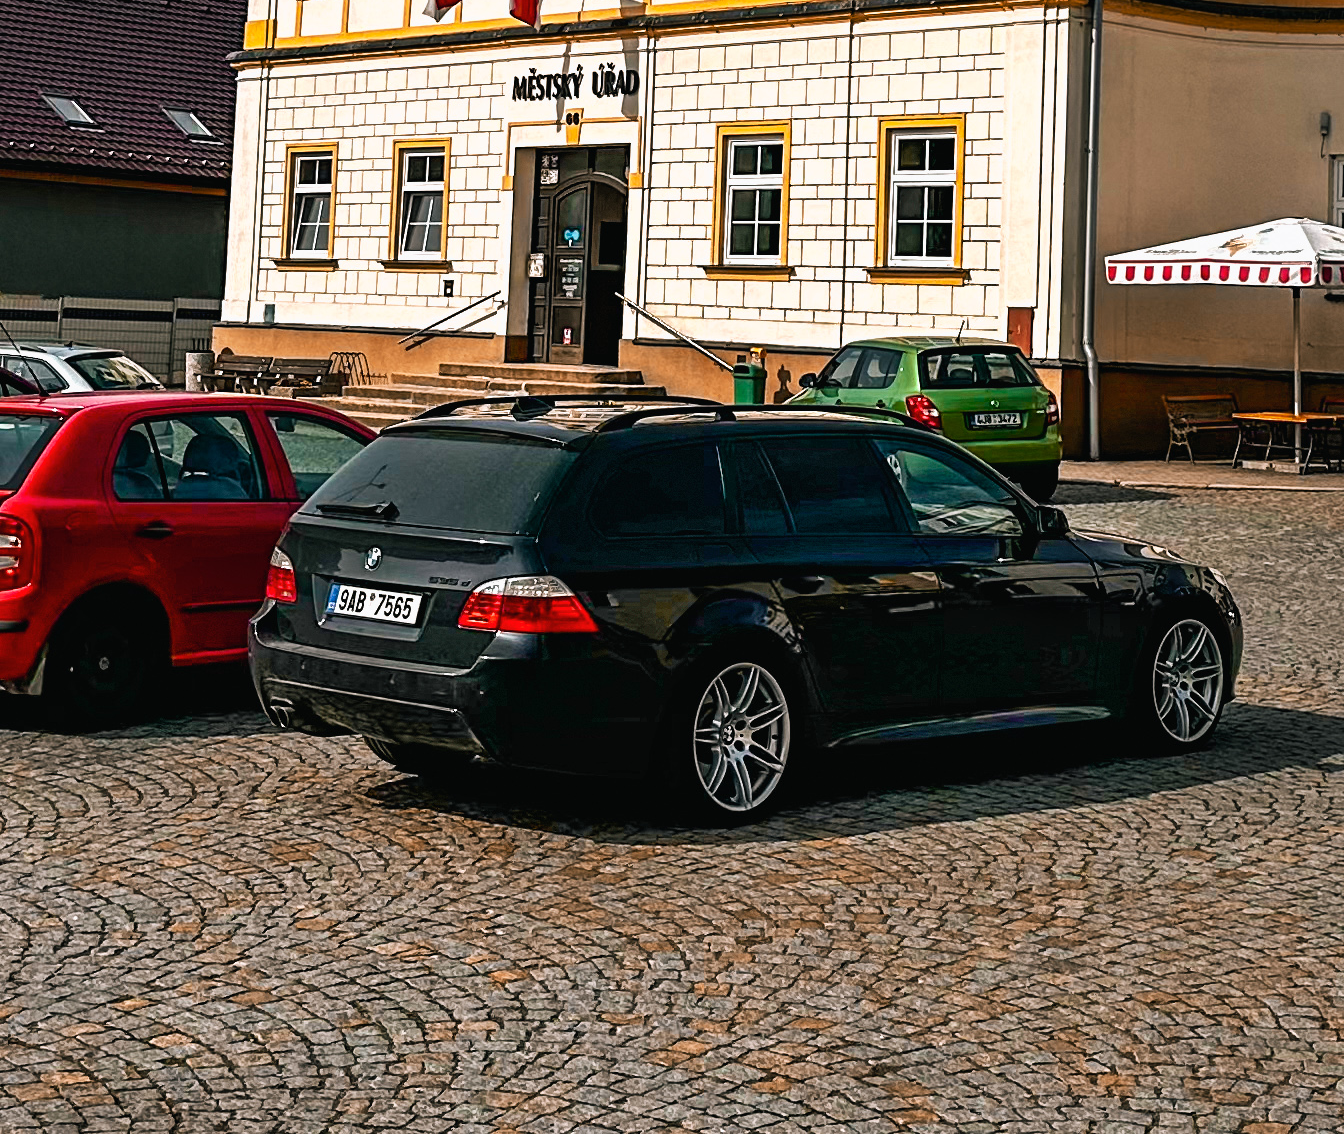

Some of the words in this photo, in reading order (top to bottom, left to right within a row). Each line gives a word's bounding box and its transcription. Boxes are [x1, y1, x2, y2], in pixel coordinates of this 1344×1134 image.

[512, 64, 584, 101] MĚSTSKÝ
[592, 62, 640, 98] ÚŘAD
[338, 589, 367, 613] 9AB
[374, 593, 414, 619] 7565
